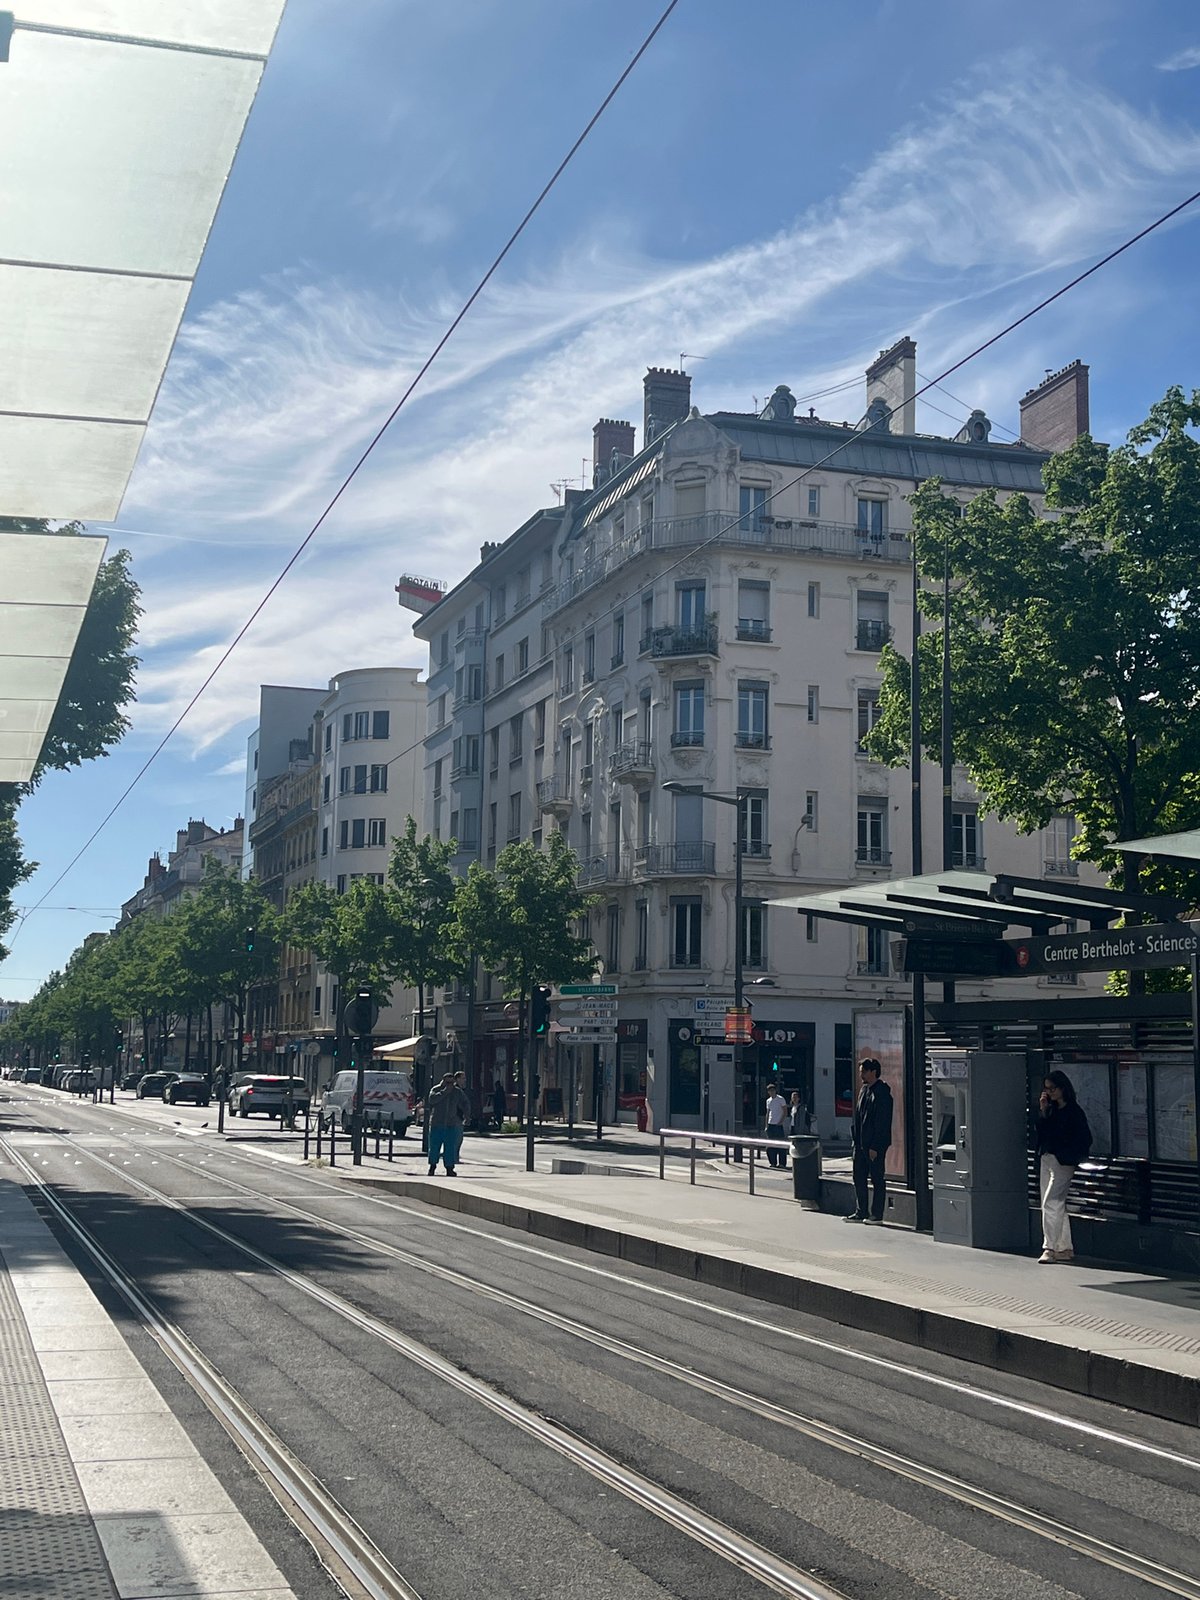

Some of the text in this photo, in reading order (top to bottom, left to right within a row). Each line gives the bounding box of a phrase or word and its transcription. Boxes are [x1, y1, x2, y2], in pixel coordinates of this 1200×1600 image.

[1044, 945, 1079, 962] Centre
[1082, 940, 1136, 959] Berthelot
[1146, 934, 1198, 954] Sciences
